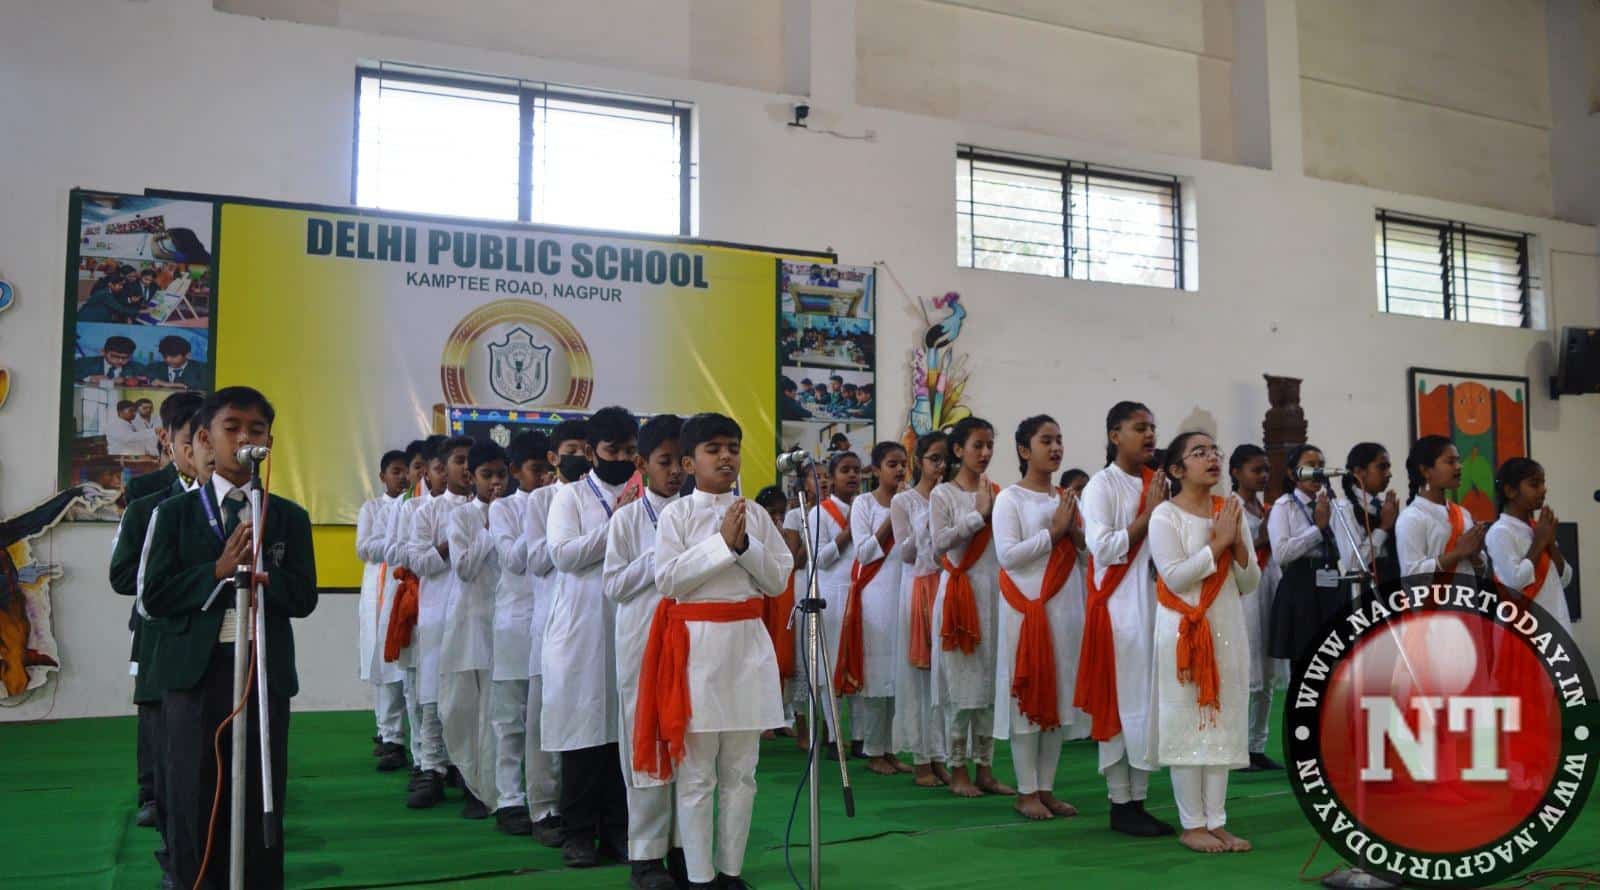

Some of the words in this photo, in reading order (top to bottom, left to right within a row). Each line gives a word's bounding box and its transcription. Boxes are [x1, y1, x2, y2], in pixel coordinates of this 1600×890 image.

[307, 218, 417, 263] DELHI
[428, 229, 561, 276] PUBLIC
[571, 243, 709, 288] SCHOOL
[406, 271, 490, 292] KAMPTEE
[495, 278, 548, 299] ROAD,
[553, 283, 622, 302] NAGPUR
